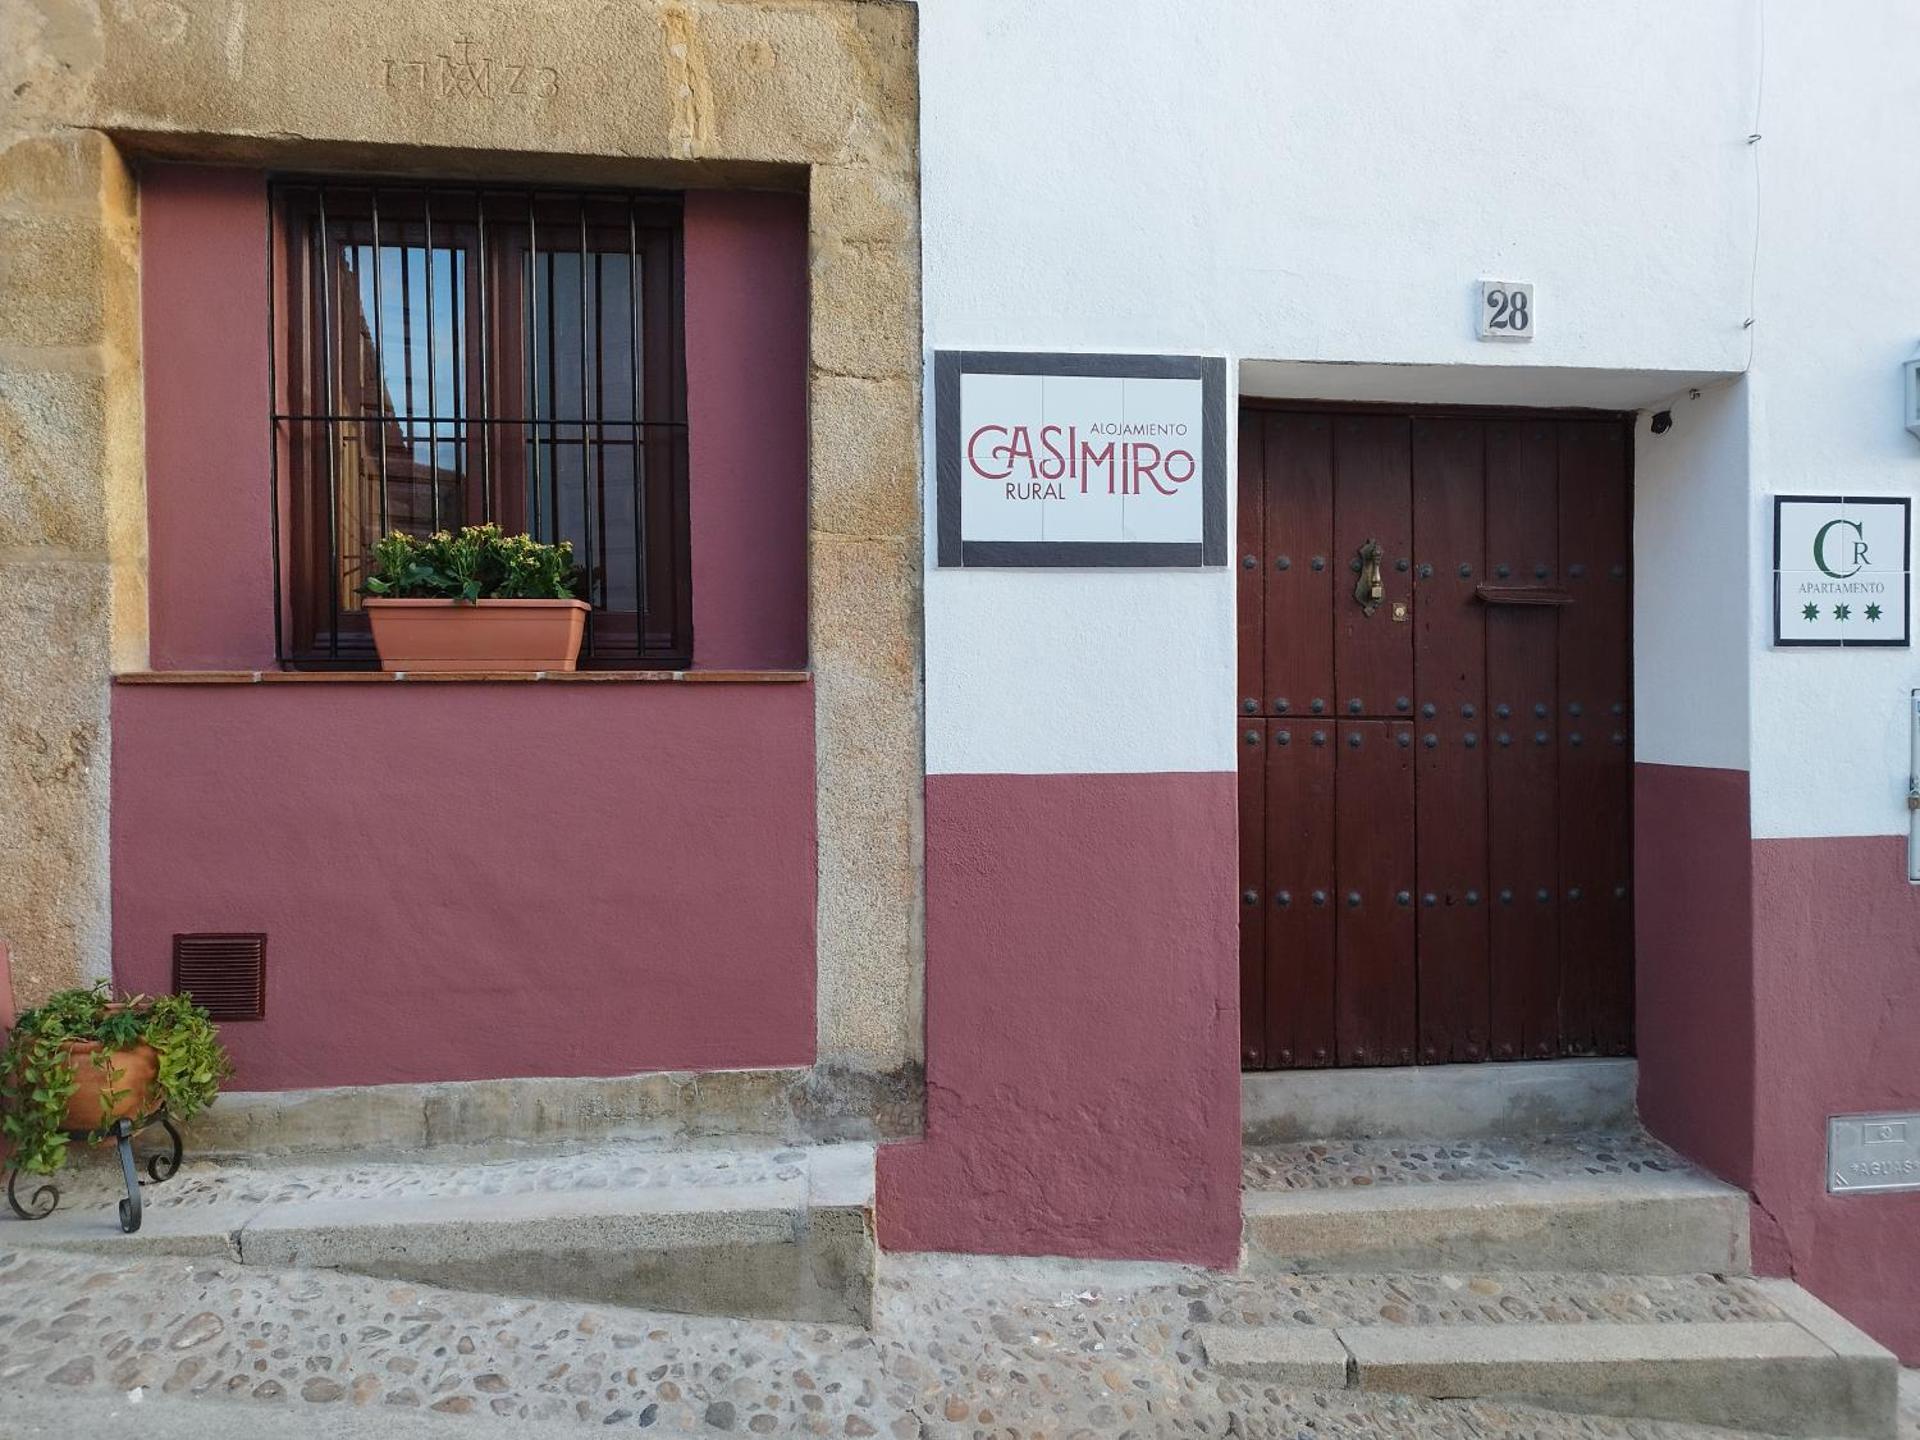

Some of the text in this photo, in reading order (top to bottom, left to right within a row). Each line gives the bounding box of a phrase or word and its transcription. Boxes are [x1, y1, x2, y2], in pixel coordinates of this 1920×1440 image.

[1487, 289, 1529, 331] 28
[1090, 422, 1188, 436] ALOJAMIENTO
[967, 424, 1196, 496] CASIMIRO
[1005, 482, 1066, 500] RURAL
[1799, 582, 1885, 594] APARTAMENTO
